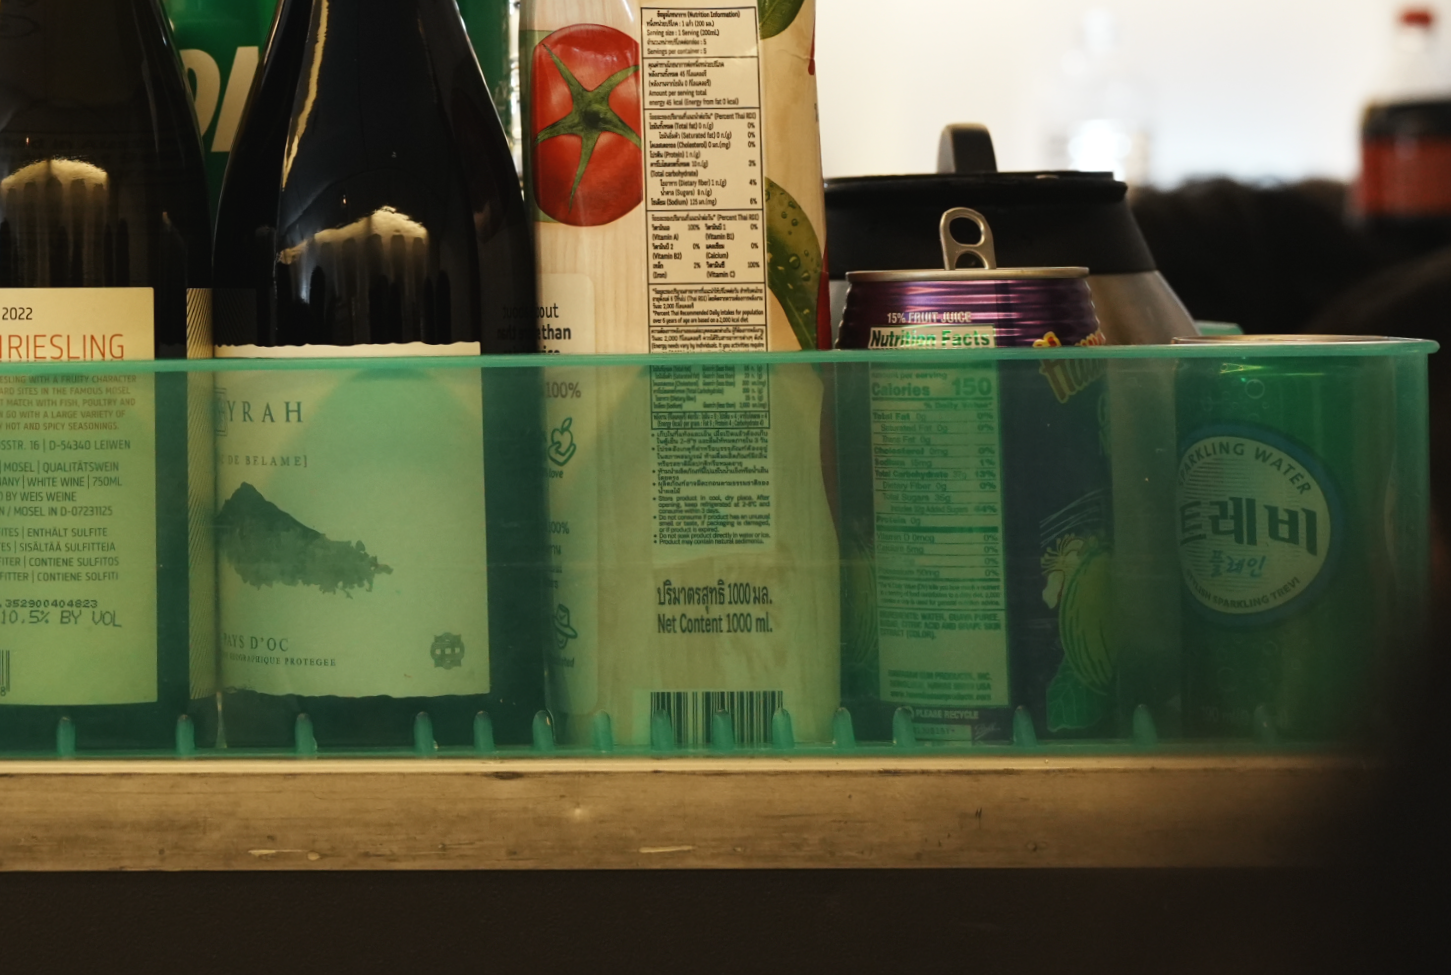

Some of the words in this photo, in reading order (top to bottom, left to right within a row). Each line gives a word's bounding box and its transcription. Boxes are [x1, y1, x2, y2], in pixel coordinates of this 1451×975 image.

[2, 307, 32, 320] 2022
[887, 313, 905, 323] 15%
[909, 312, 938, 323] FRUIT
[941, 312, 971, 322] JUICE
[870, 330, 936, 346] Nutrition
[942, 331, 990, 346] Facts
[9, 334, 124, 360] RIESLING
[61, 375, 90, 383] FRUITY
[92, 375, 137, 383] CHARACTER
[17, 387, 38, 395] SITES
[53, 387, 67, 395] THE
[70, 387, 102, 395] FAMOUS
[106, 386, 130, 394] MOSEL
[872, 383, 930, 396] Calories
[952, 377, 991, 396] 150
[6, 399, 33, 407] MATCH
[36, 399, 57, 407] WITH
[60, 399, 80, 408] FISH,
[83, 398, 117, 407] POULTRY
[120, 398, 135, 406] AND
[6, 410, 16, 418] GO
[20, 410, 40, 418] WITH
[52, 410, 77, 418] LARGE
[81, 410, 112, 418] VARIETY
[116, 410, 125, 418] OF
[6, 422, 20, 430] HOT
[24, 422, 40, 430] AND
[43, 422, 65, 430] SPICY
[68, 422, 119, 430] SEASONINGS.
[30, 440, 39, 450] 16
[49, 440, 90, 450] D-54340
[95, 440, 131, 449] LEIWEN
[4, 462, 35, 472] MOSEL
[43, 460, 119, 472] QUALITÄTSWEIN
[1254, 447, 1312, 495] WATER
[28, 477, 57, 487] WHITE
[61, 477, 85, 487] WINE
[93, 476, 122, 487] 750ML
[6, 492, 17, 501] BY
[20, 492, 43, 501] WEIS
[46, 492, 76, 502] WEINE
[14, 506, 45, 516] MOSEL
[49, 506, 57, 516] IN
[60, 506, 112, 516] D-07231125
[28, 527, 67, 537] ENTHÄLT
[72, 527, 107, 537] SULFITE
[1179, 497, 1318, 556] 트레비
[20, 541, 61, 552] SISÄLTÄÄ
[65, 542, 115, 552] SULFITTEJA
[29, 556, 74, 566] CONTIENE
[77, 556, 119, 566] SULFITOS
[1209, 549, 1266, 578] 플레인
[37, 571, 82, 581] CONTIENE
[85, 571, 118, 581] SOLFITI
[728, 583, 750, 604] 1000
[1212, 594, 1269, 609] SPARKLING
[1272, 577, 1300, 600] TREVI
[1, 610, 49, 624] 10.5%
[60, 610, 81, 624] BY
[92, 611, 122, 627] VOL
[657, 614, 676, 633] Net
[680, 614, 723, 633] Content
[726, 613, 752, 633] 1000
[756, 612, 773, 632] ml.
[285, 658, 335, 666] PROTEGEE
[944, 710, 979, 719] RECYCLE
